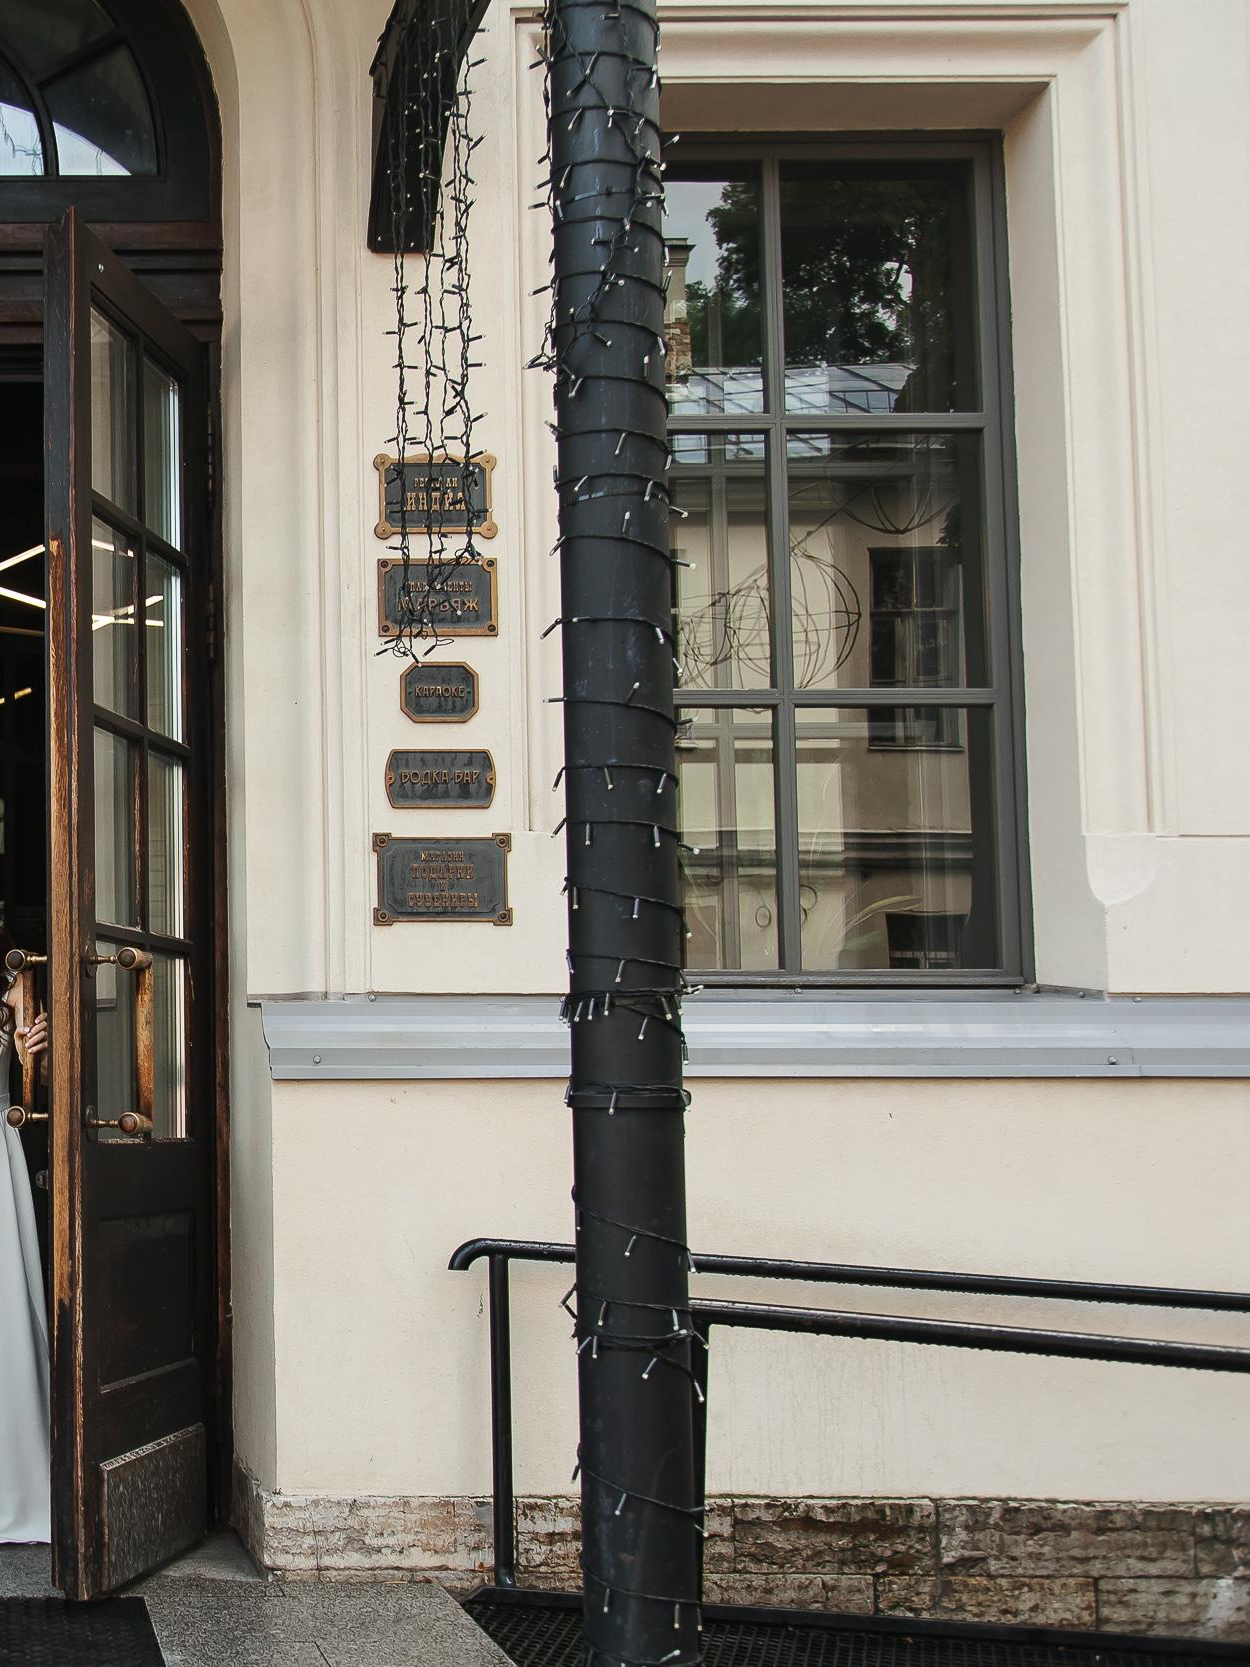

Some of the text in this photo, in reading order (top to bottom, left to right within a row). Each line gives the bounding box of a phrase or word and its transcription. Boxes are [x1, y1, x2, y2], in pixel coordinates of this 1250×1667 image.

[414, 685, 467, 697] КАРАОКЕ
[411, 864, 475, 880] ПОДАРКИ
[406, 892, 479, 909] СУВЕНИРЫ
